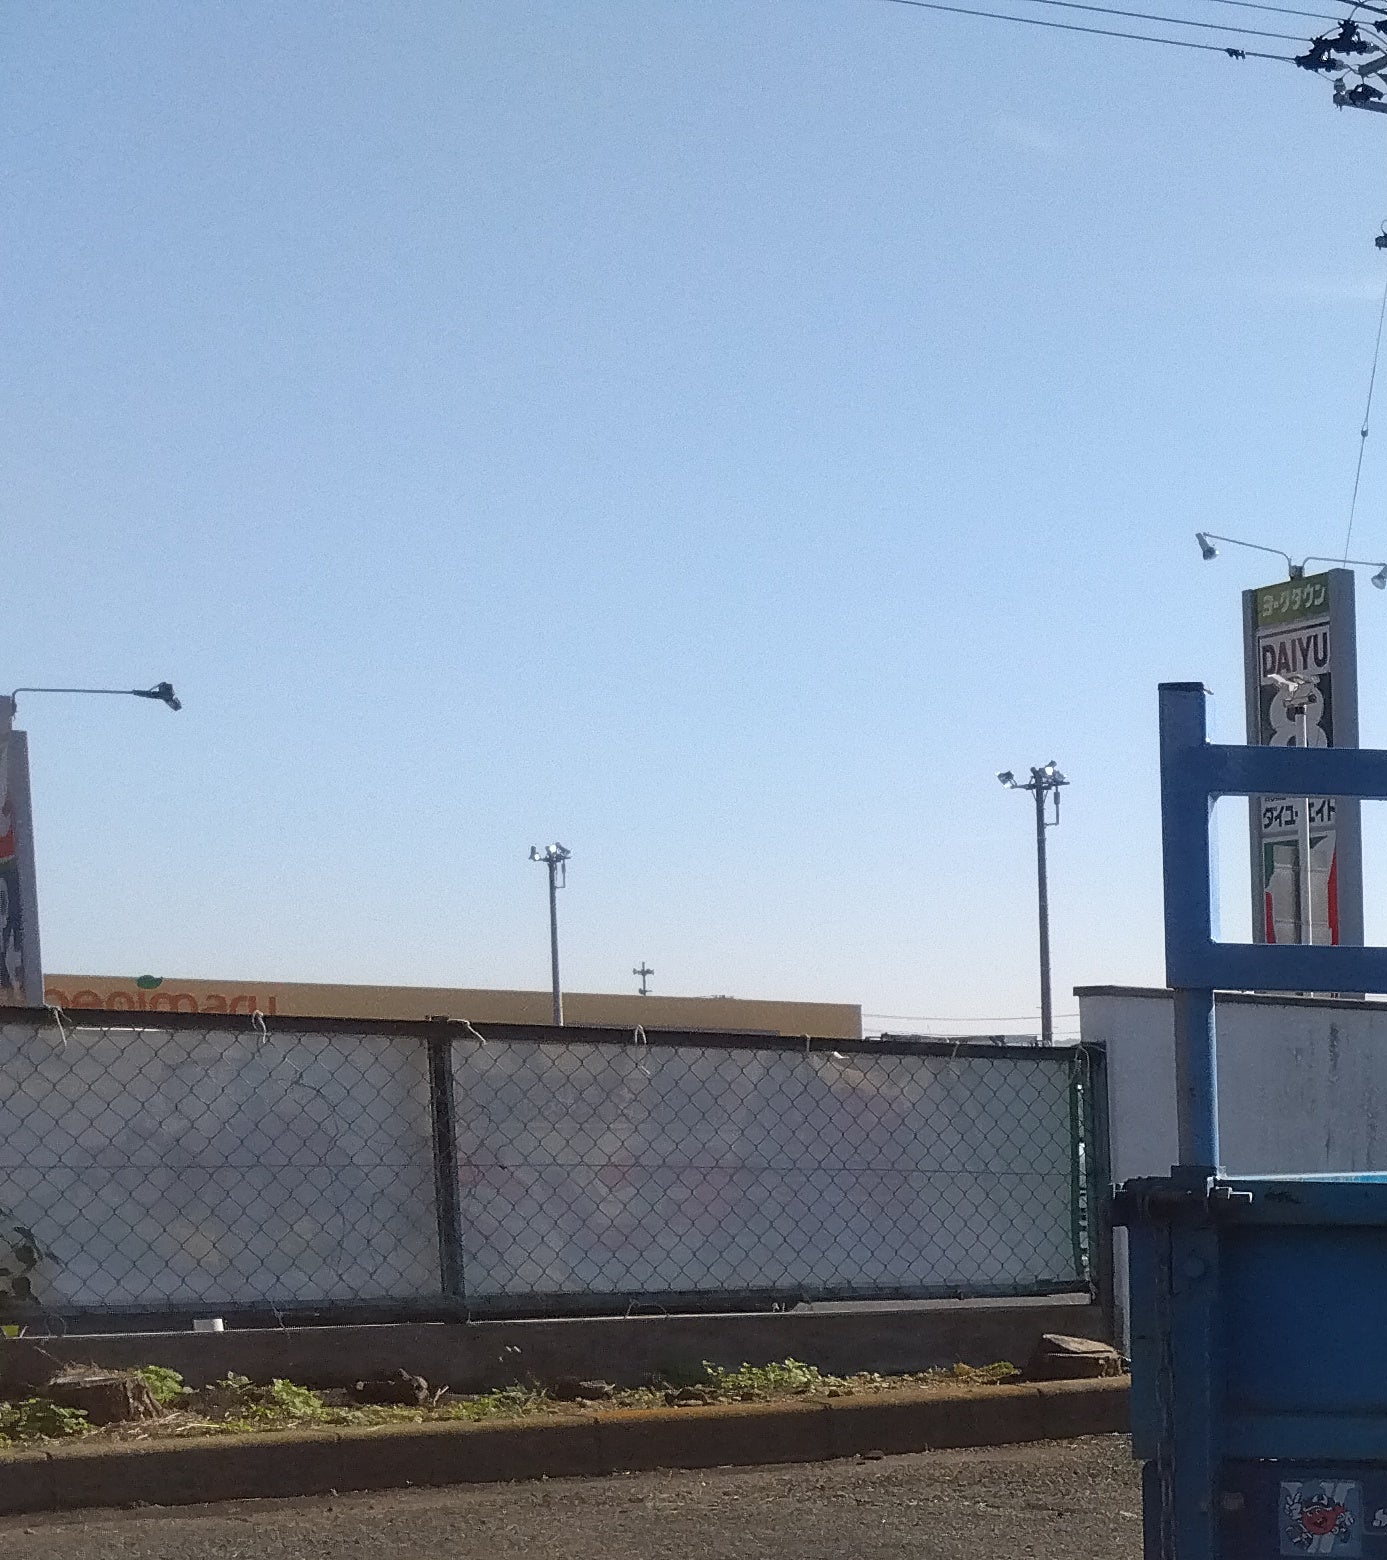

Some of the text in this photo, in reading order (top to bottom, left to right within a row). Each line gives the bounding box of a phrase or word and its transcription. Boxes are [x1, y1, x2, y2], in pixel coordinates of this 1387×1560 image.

[1262, 583, 1327, 617] ヨークタウン
[1262, 632, 1328, 678] DAIYU
